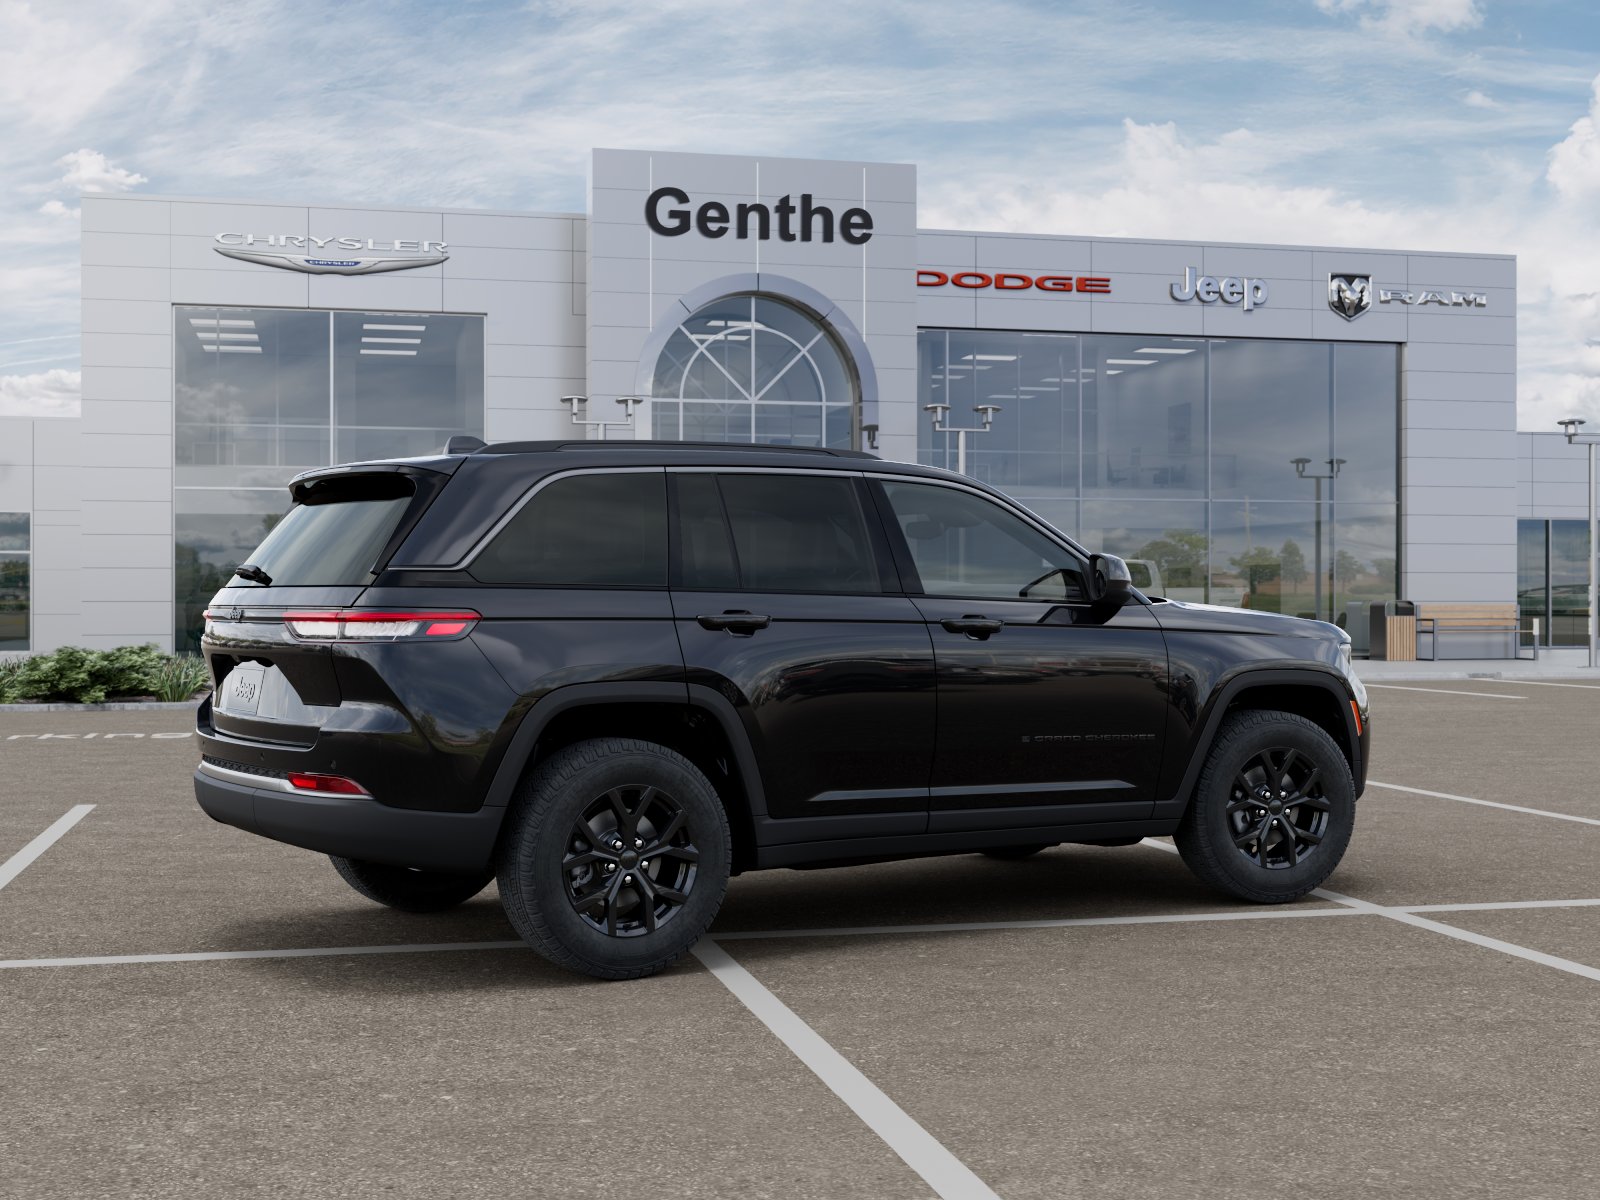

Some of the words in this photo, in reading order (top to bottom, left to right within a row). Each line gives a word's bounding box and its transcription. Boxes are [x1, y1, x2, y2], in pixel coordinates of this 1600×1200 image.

[645, 187, 874, 245] Genthe
[214, 232, 449, 253] CHRYSLER
[916, 270, 1112, 294] DODGE
[1169, 266, 1269, 311] Jeep
[1379, 289, 1487, 308] RAM
[235, 676, 256, 703] Jeep
